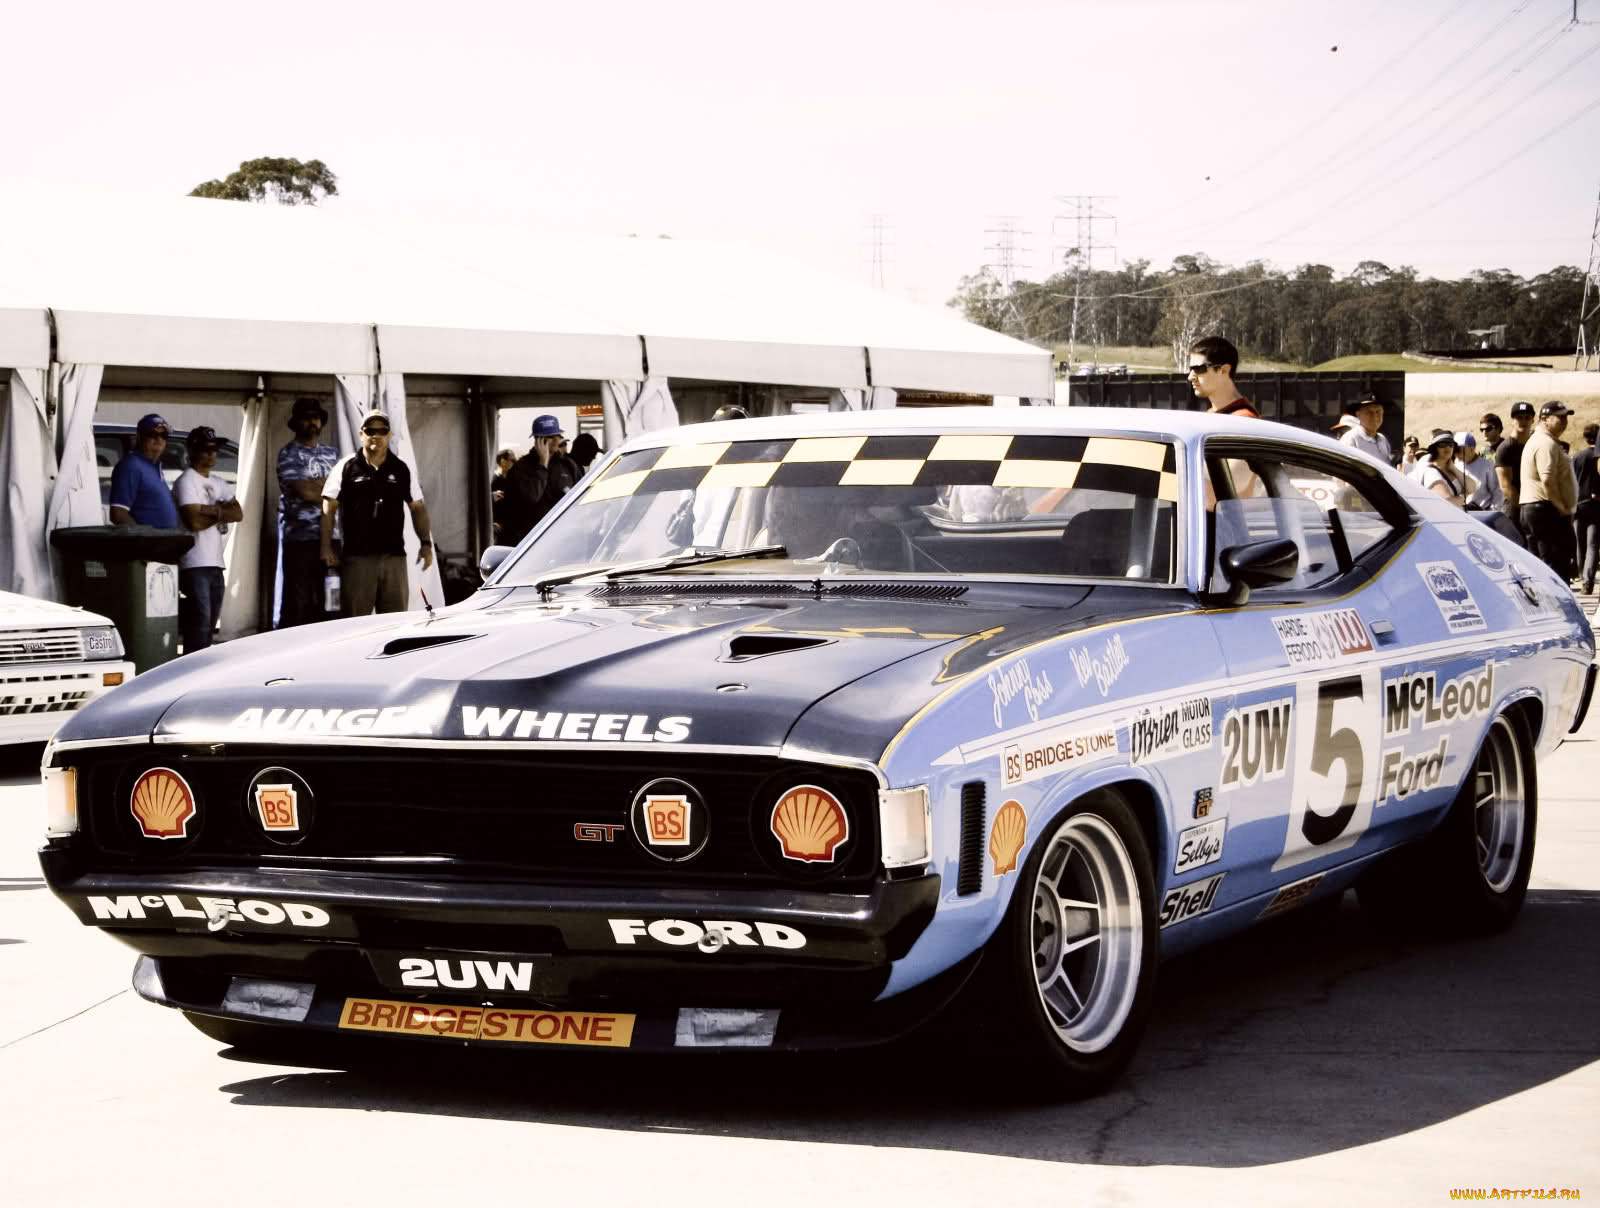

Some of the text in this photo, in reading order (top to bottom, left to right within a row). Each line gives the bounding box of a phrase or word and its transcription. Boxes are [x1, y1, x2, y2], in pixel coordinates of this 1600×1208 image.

[1285, 640, 1322, 662] FERODO
[230, 705, 693, 742] AUNGE WHEELS
[1181, 697, 1210, 722] MOTOR
[1183, 723, 1211, 749] GLASS
[1221, 703, 1291, 785] 2UW
[1007, 753, 1022, 780] BS
[1301, 673, 1364, 846] 5
[1378, 738, 1447, 802] Ford
[264, 799, 291, 823] BS
[652, 810, 682, 836] BS
[573, 823, 625, 842] GT
[1177, 835, 1220, 867] Selby's
[1160, 876, 1222, 926] Shell
[607, 919, 807, 949] FORD
[399, 958, 533, 991] 2UW
[347, 1001, 616, 1042] BRIDGESTONE
